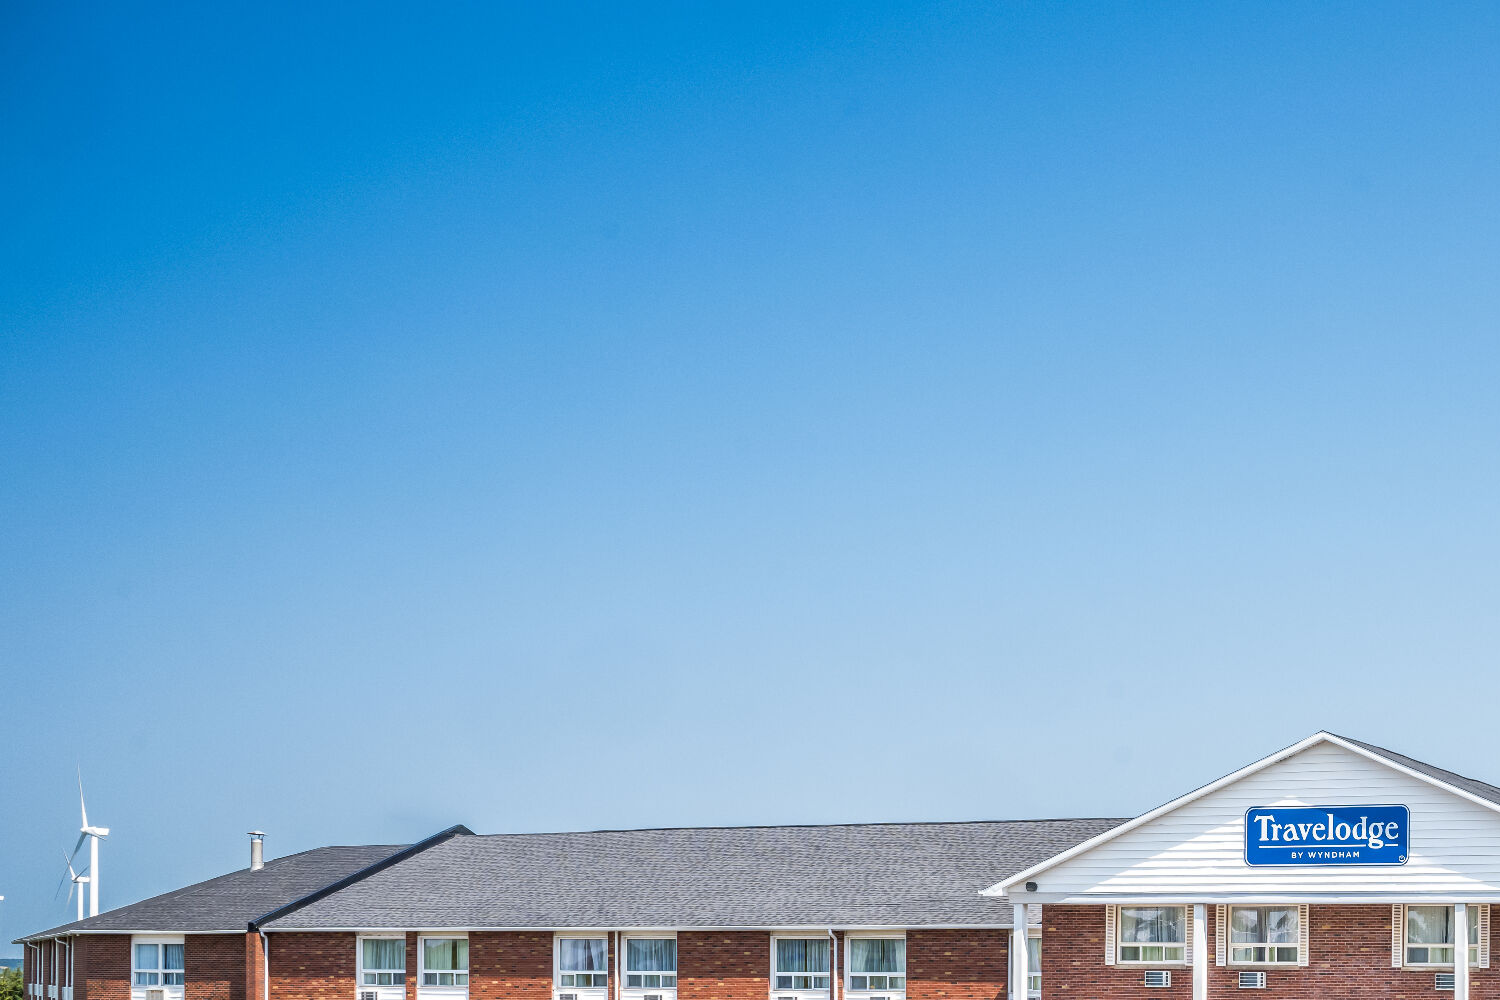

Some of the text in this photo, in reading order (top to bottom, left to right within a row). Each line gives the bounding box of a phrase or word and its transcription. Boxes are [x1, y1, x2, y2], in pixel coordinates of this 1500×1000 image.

[1253, 813, 1399, 849] Travelodge
[1291, 851, 1360, 859] BY WYNDHAM
